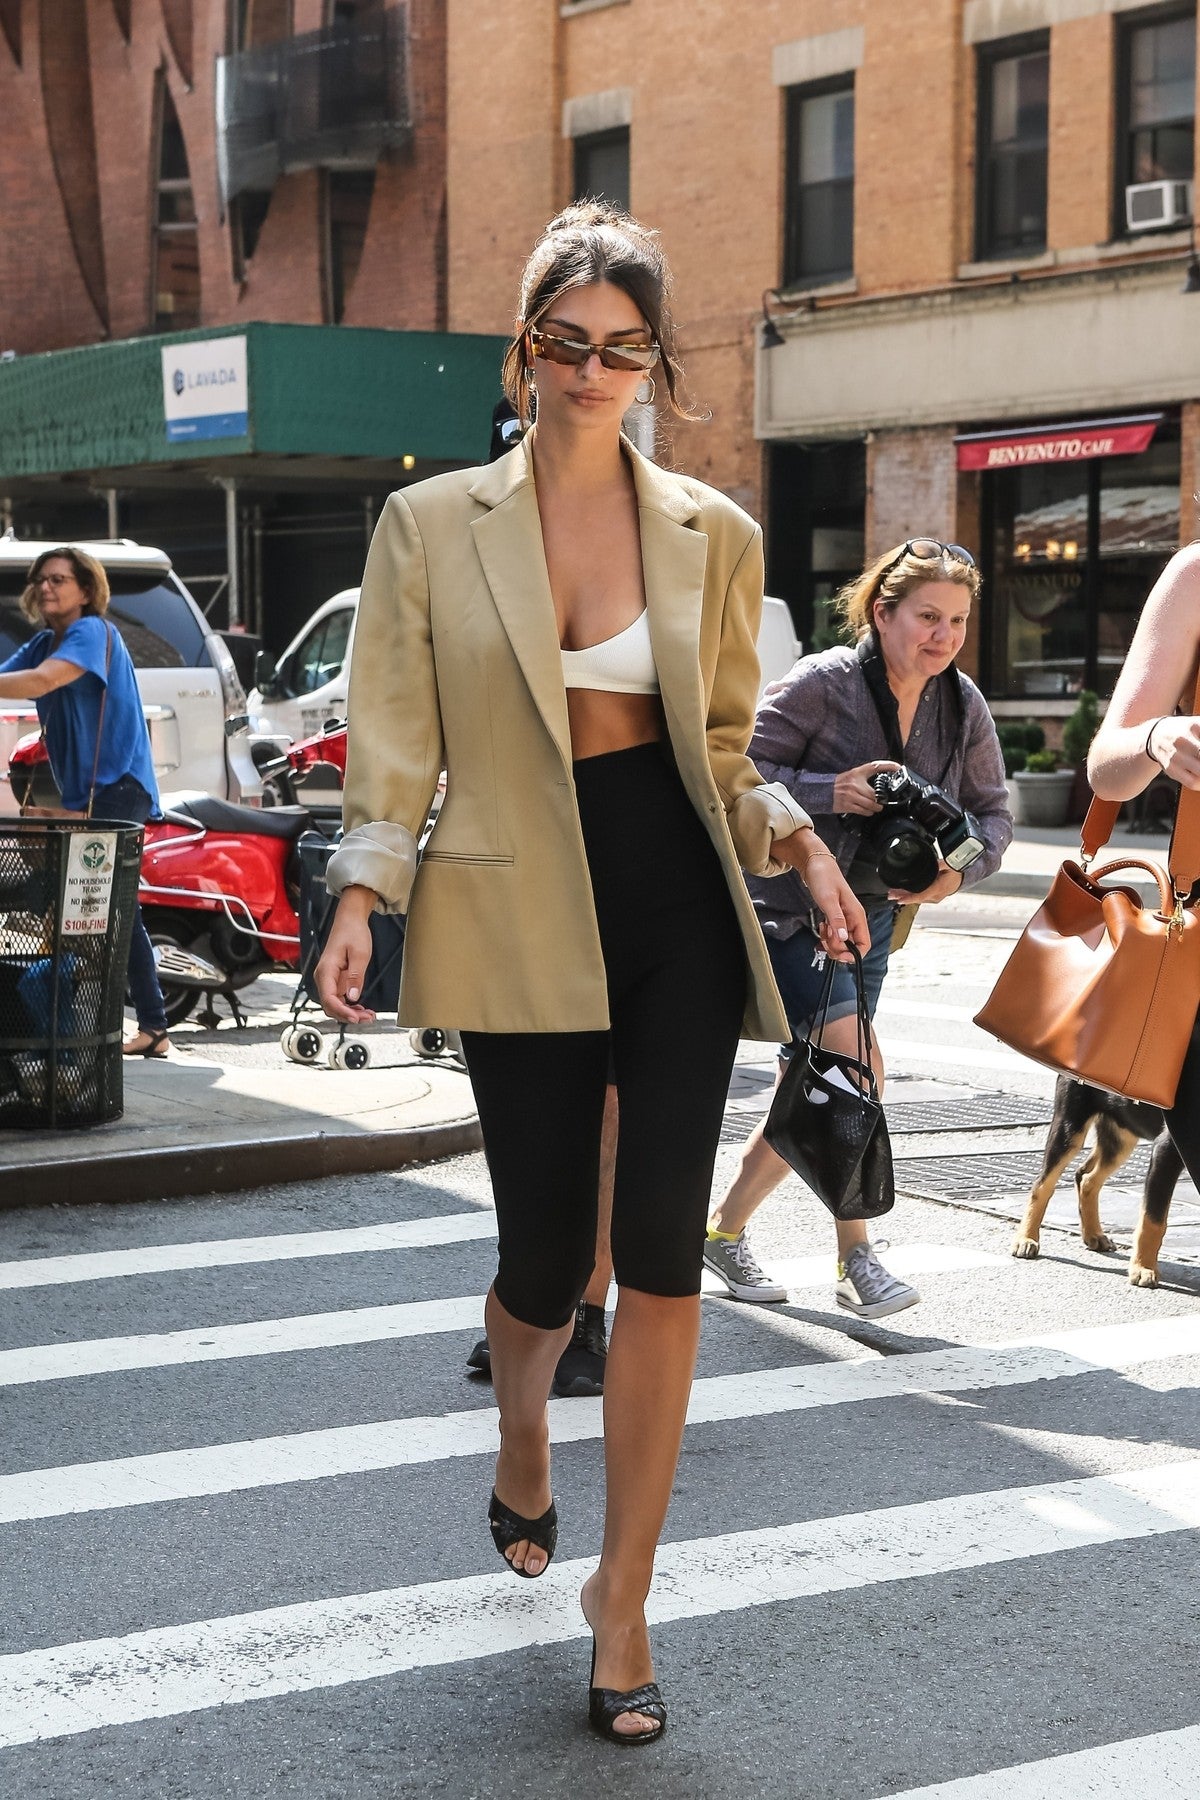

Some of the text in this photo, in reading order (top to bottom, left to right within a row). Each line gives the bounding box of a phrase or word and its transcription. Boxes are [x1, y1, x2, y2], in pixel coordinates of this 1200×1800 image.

[188, 368, 236, 388] LAVADA
[988, 439, 1081, 465] BENVENUTO
[79, 877, 111, 885] HOUSEHOLD
[65, 918, 106, 930] $100 FINE
